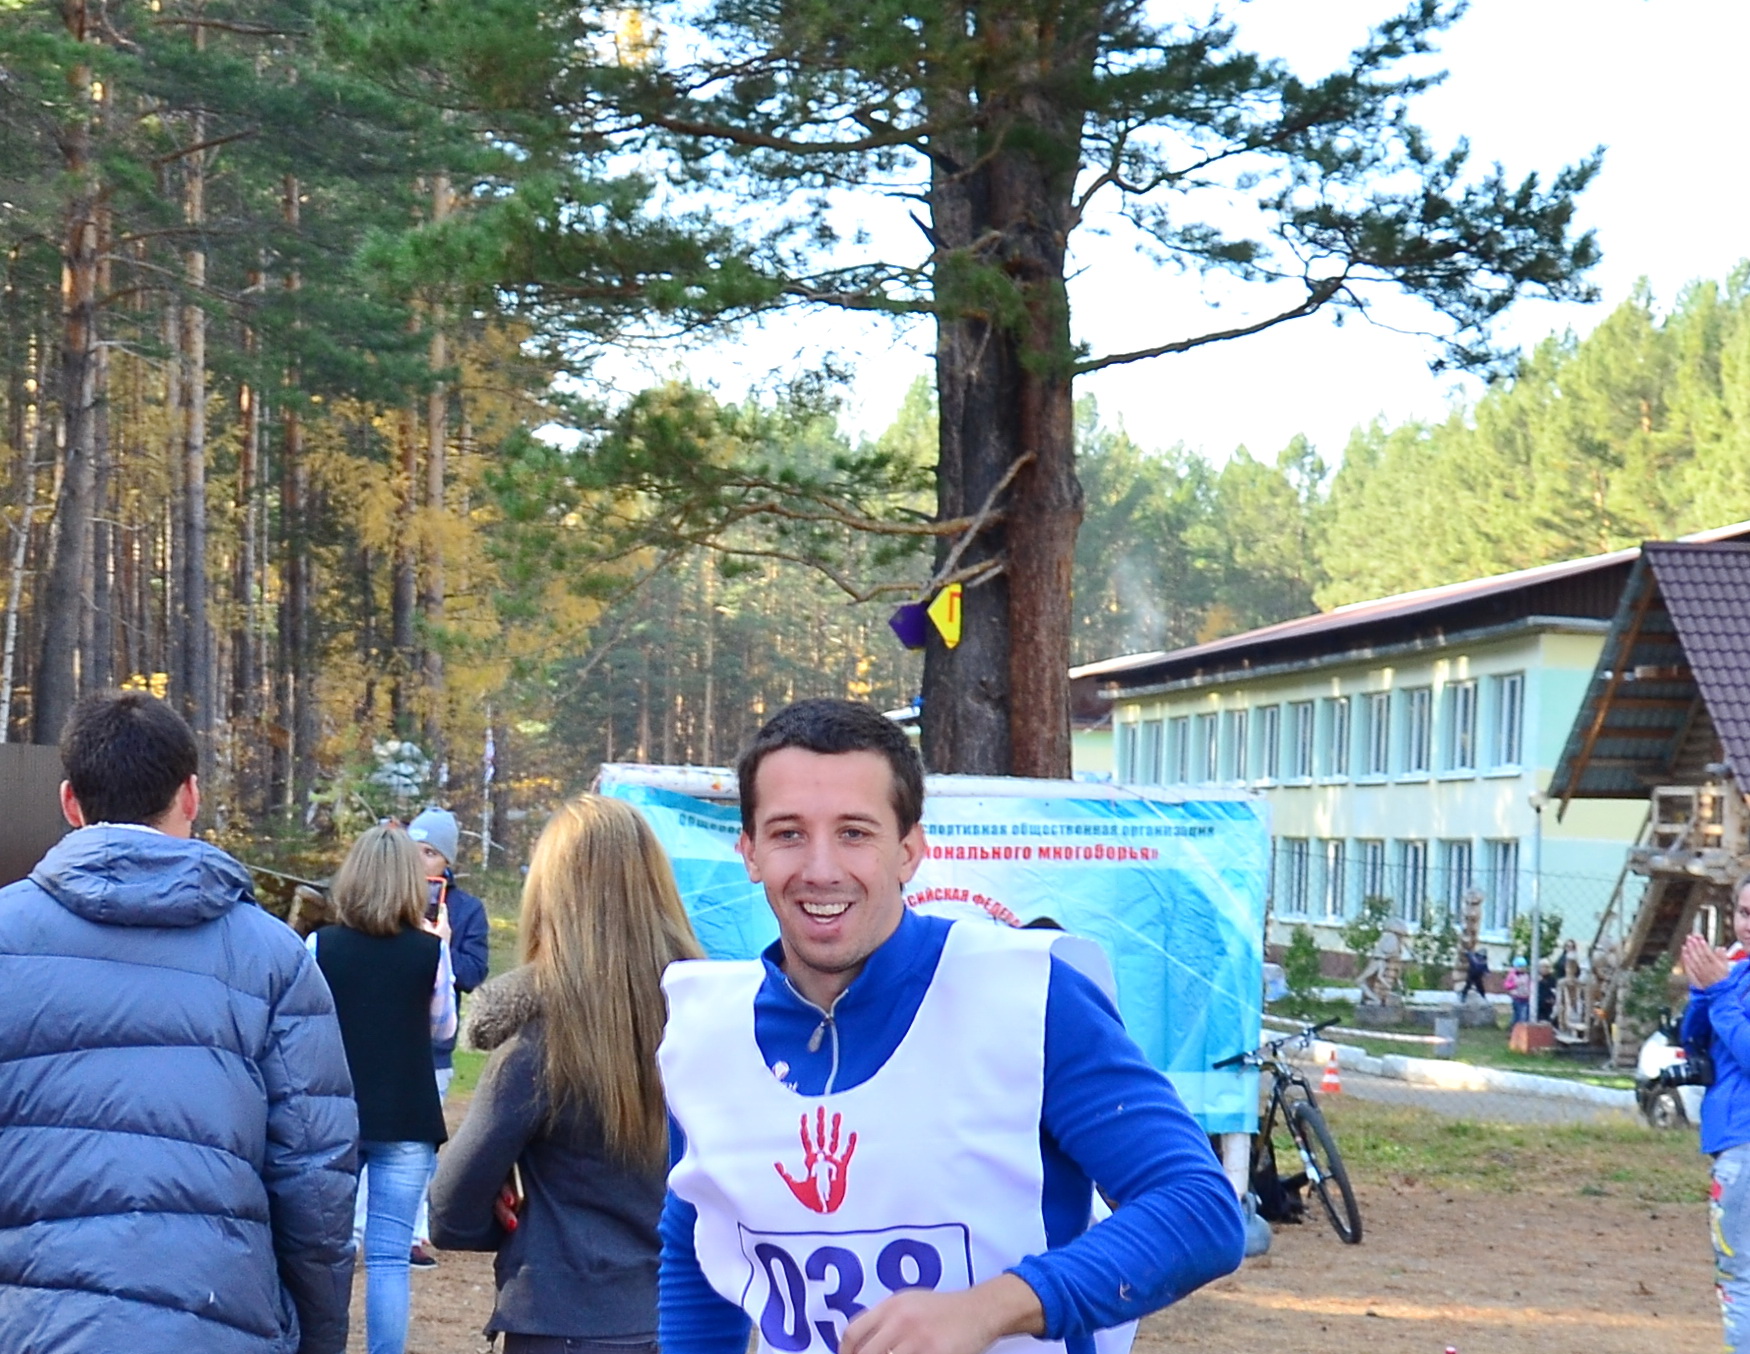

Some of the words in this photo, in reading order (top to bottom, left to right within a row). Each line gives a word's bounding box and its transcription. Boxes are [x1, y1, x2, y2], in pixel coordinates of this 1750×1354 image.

[1011, 822, 1118, 836] общественная
[1121, 823, 1215, 837] организация
[906, 886, 970, 907] СИЙСКАЯ
